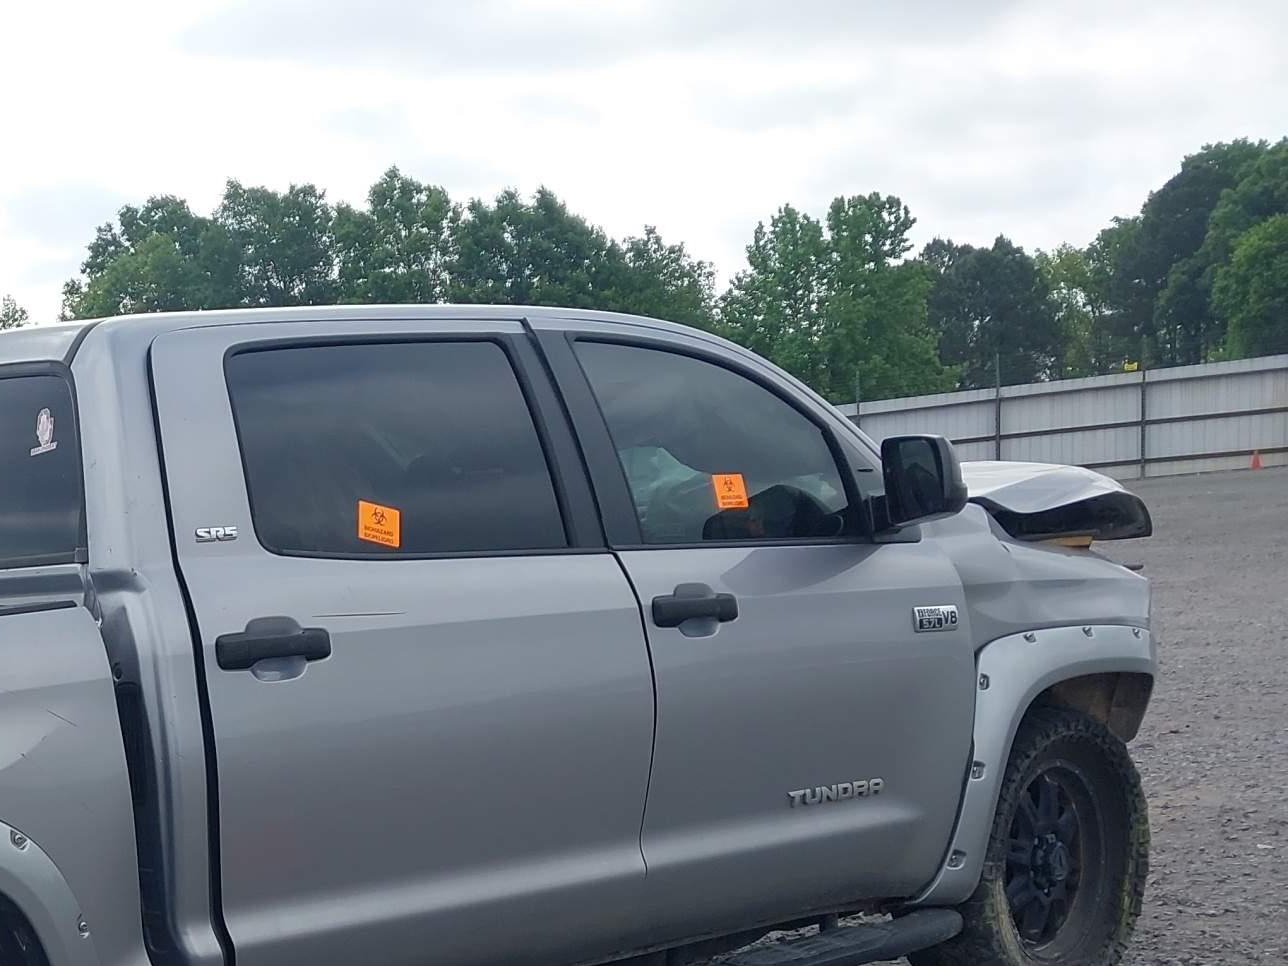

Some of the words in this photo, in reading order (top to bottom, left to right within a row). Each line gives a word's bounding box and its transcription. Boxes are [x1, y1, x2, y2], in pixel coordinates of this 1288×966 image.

[195, 526, 238, 542] SR5
[942, 610, 958, 625] V8
[787, 777, 886, 807] TUNDRA
